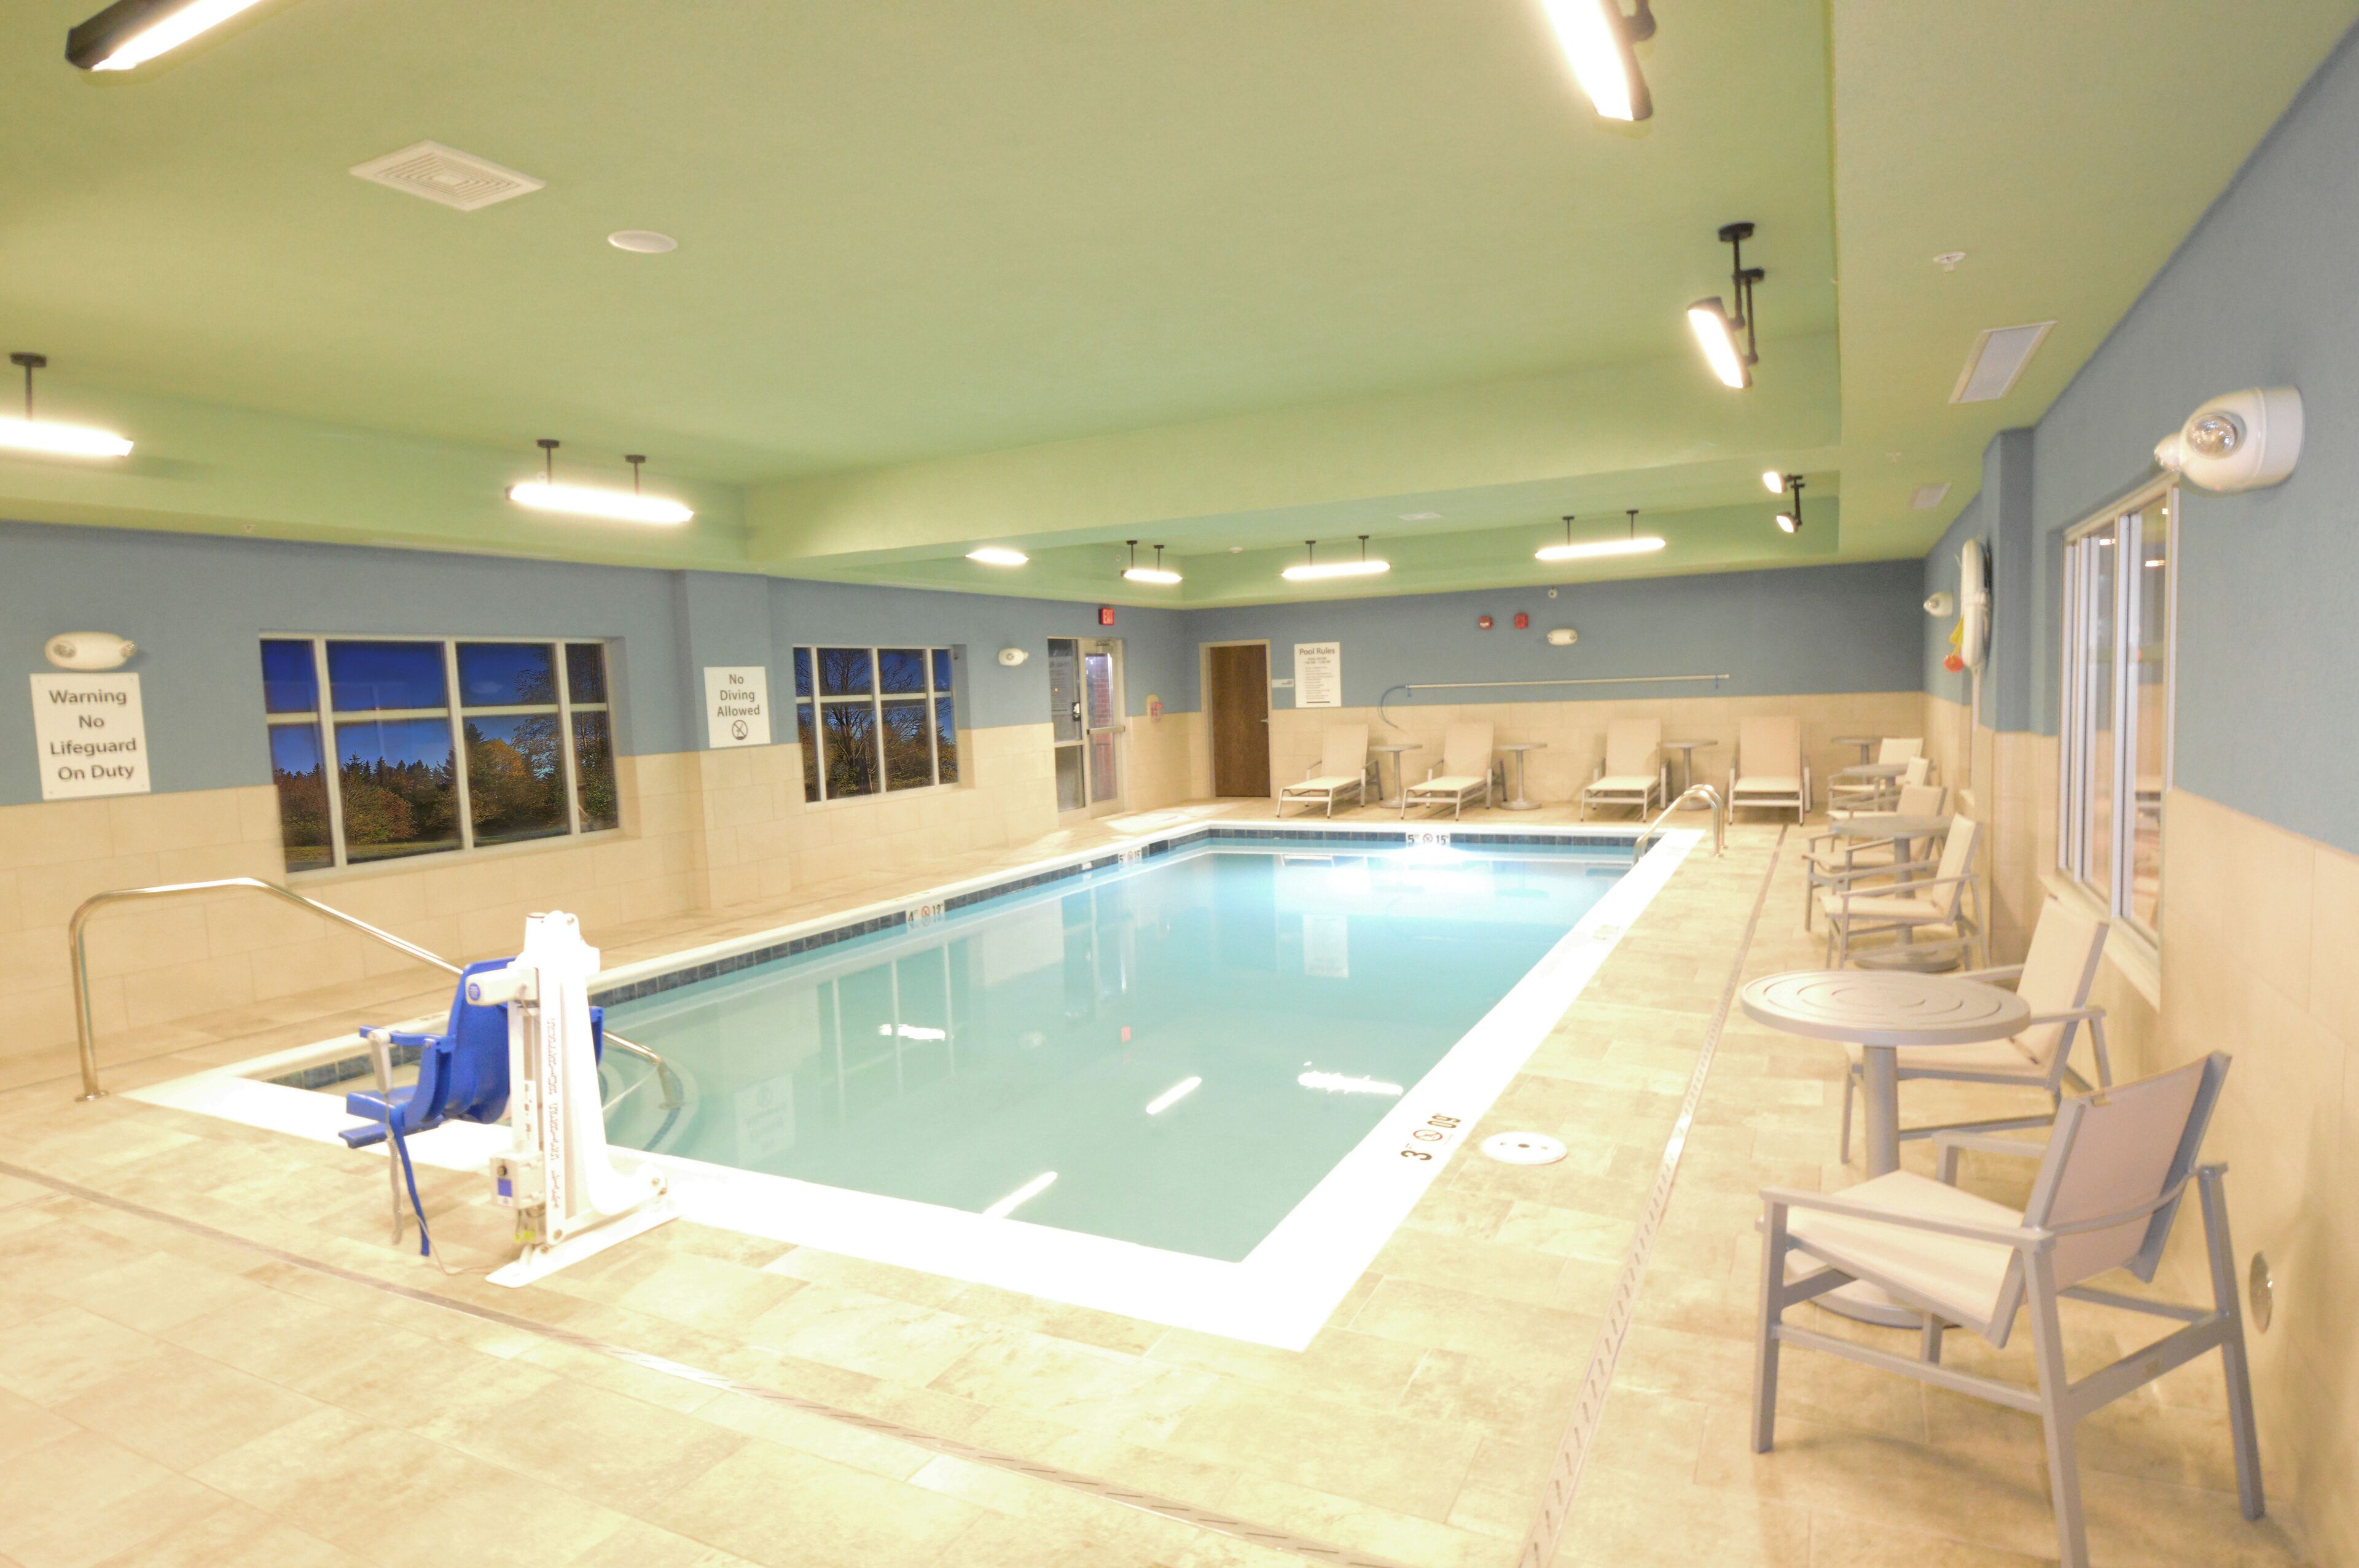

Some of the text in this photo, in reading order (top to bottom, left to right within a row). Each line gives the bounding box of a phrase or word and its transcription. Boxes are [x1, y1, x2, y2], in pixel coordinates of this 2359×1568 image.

[729, 674, 744, 684] No
[49, 689, 127, 705] Warning
[720, 690, 755, 702] Diving
[718, 704, 761, 717] Allowed
[79, 715, 104, 728] No
[50, 738, 137, 757] Lifeguard
[58, 765, 135, 780] On Duty
[1401, 1150, 1433, 1160] 3
